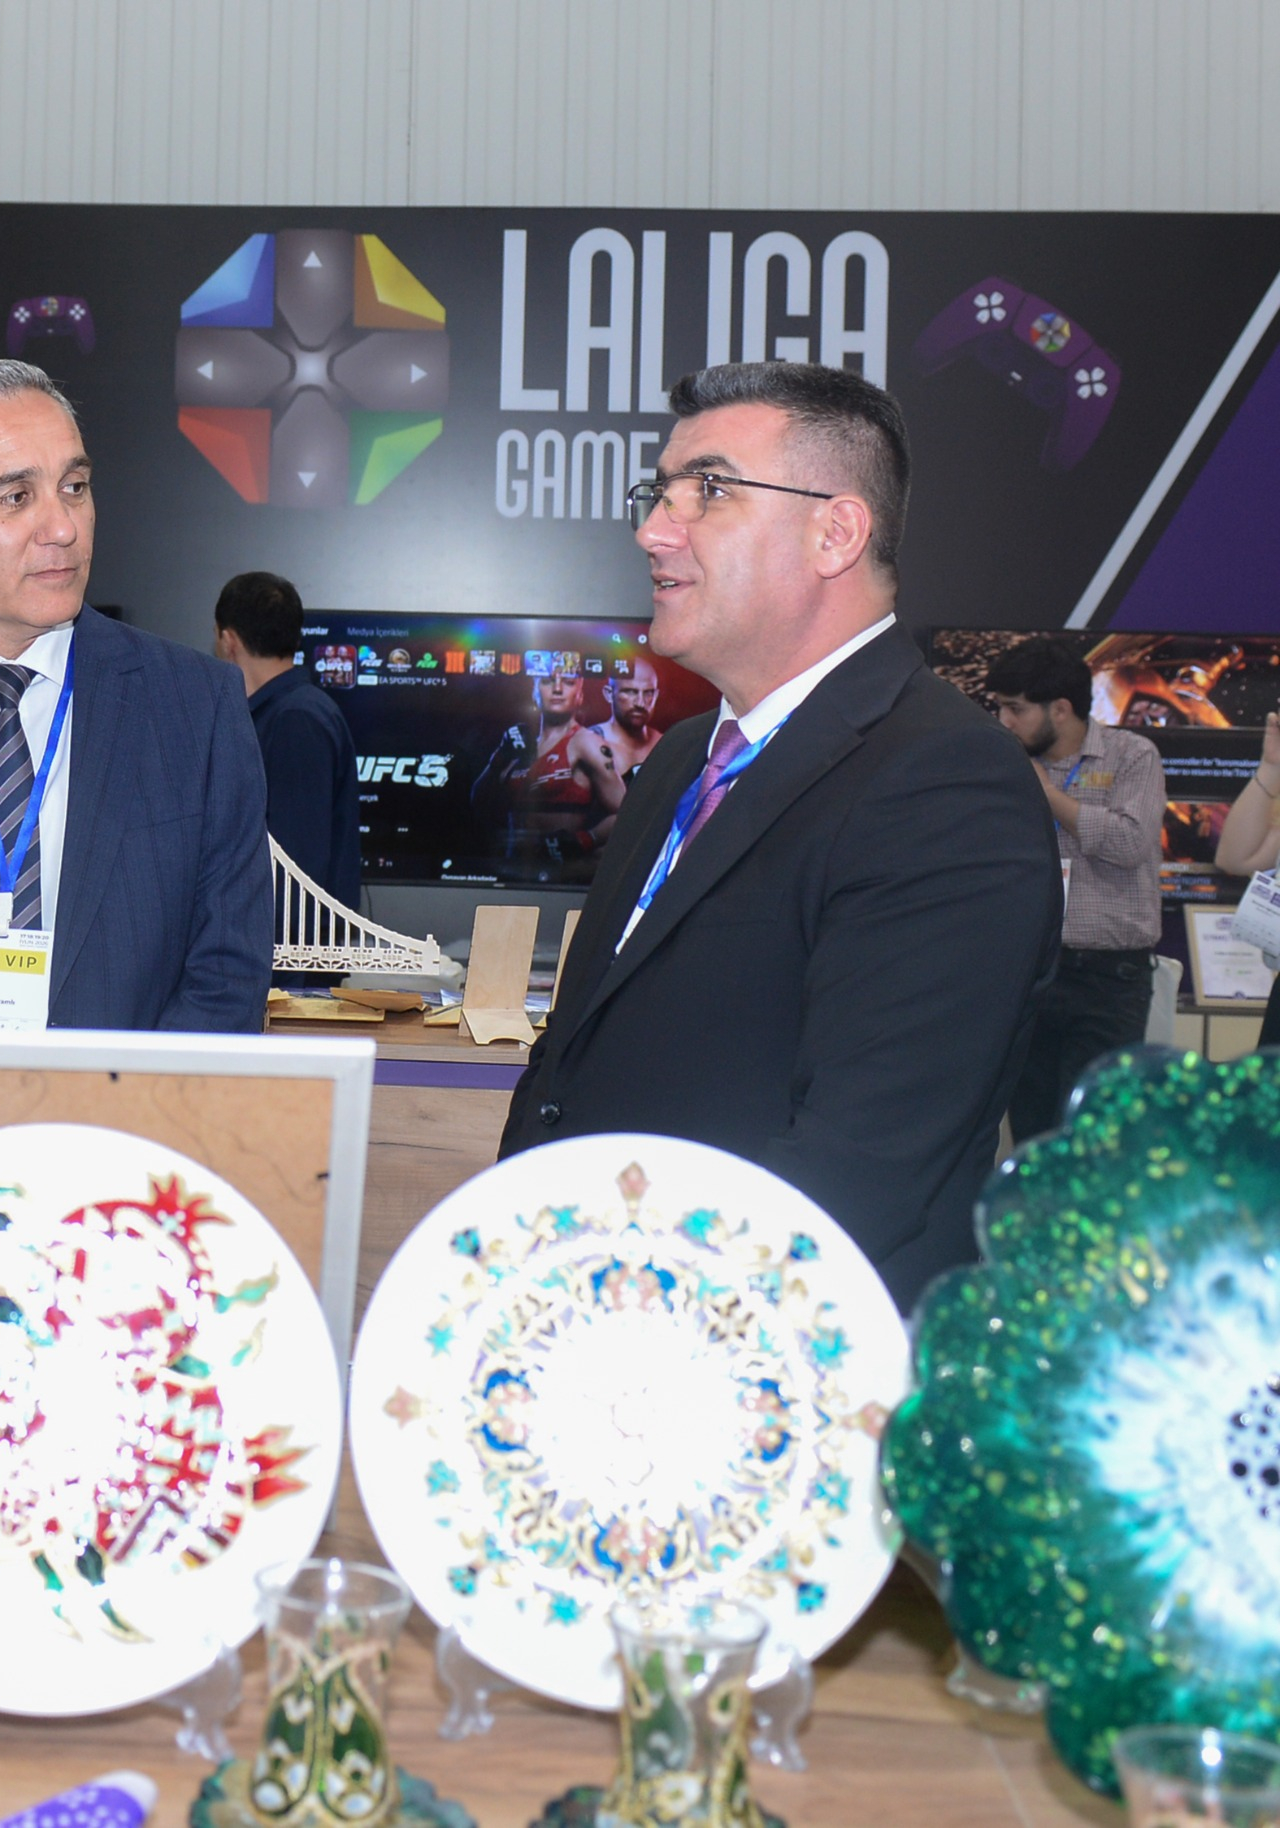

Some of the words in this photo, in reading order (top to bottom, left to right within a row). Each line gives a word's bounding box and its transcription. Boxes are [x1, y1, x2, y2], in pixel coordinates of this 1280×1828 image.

[499, 227, 889, 415] LALIGA
[496, 428, 661, 520] GAME
[301, 627, 329, 637] yunlar
[347, 627, 375, 637] Medya
[379, 676, 388, 685] EA
[508, 726, 526, 749] UFC
[6, 955, 37, 968] VIP
